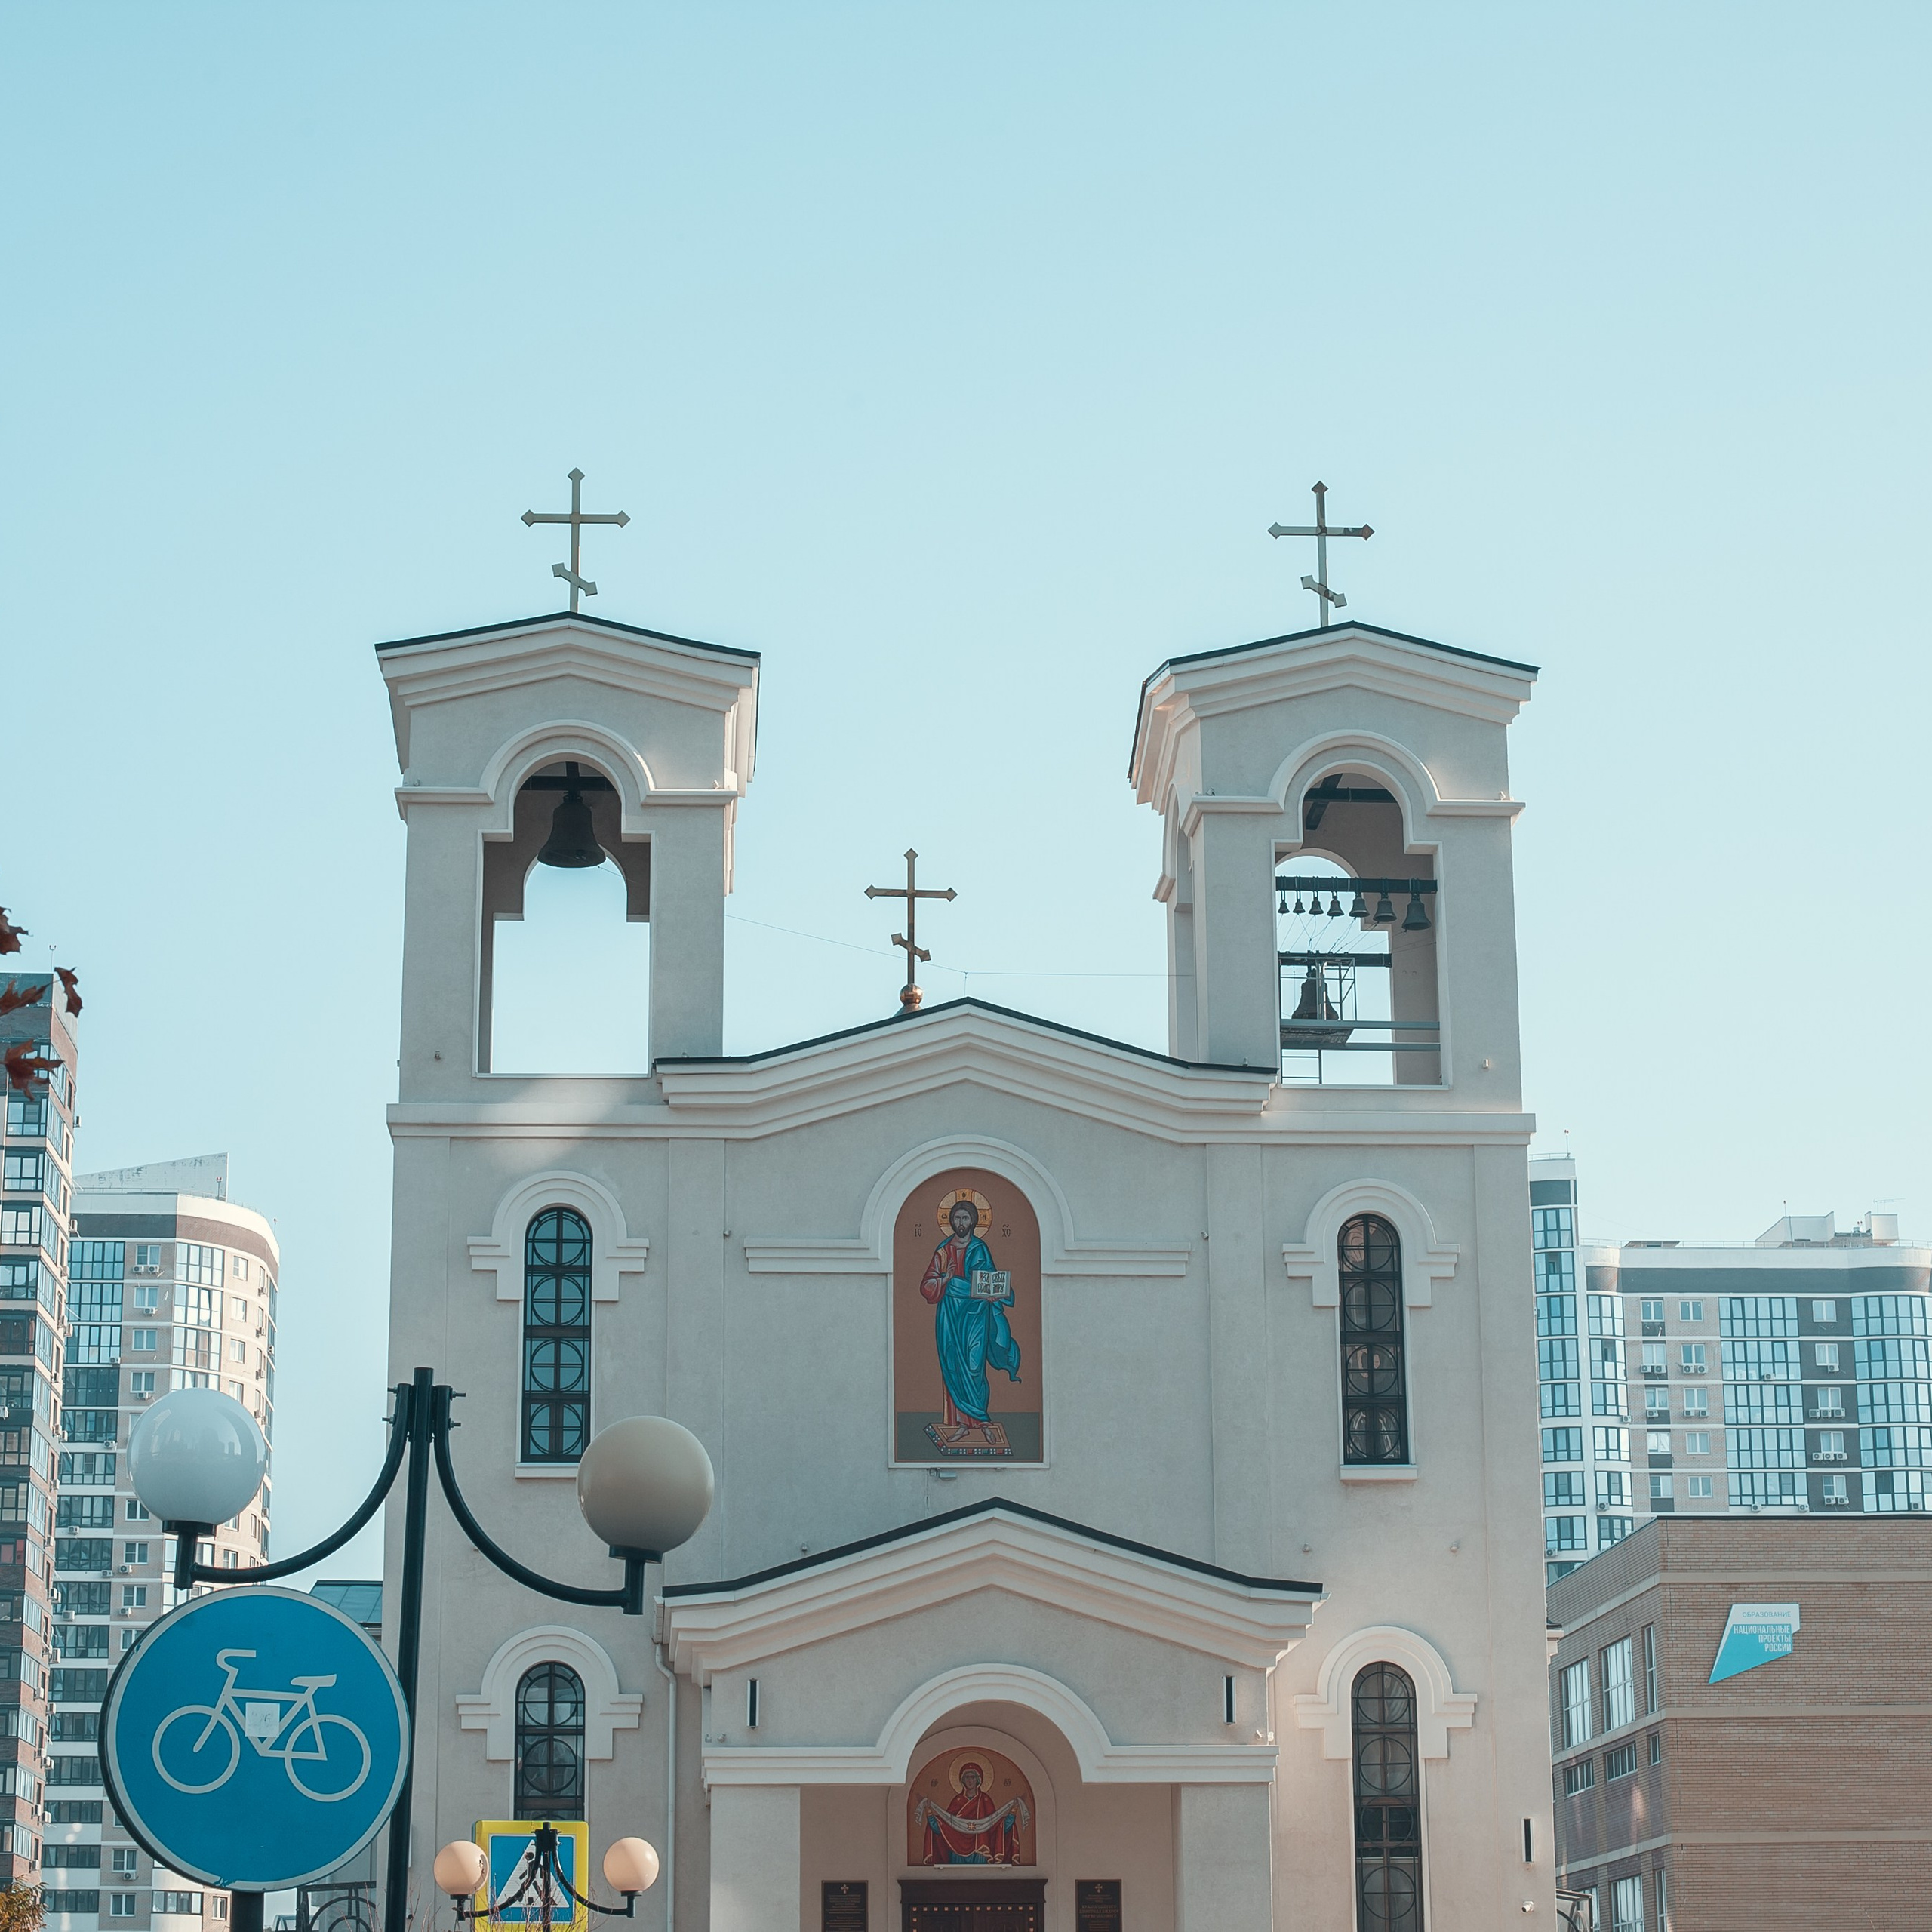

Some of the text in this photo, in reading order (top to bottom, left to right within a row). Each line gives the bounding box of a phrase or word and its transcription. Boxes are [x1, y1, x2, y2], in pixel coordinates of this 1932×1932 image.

[1734, 1625, 1790, 1635] НАЦИОНАЛЬНЫЕ
[1758, 1635, 1791, 1643] ПРОЕКТЫ
[1764, 1643, 1792, 1652] РОССИИ
